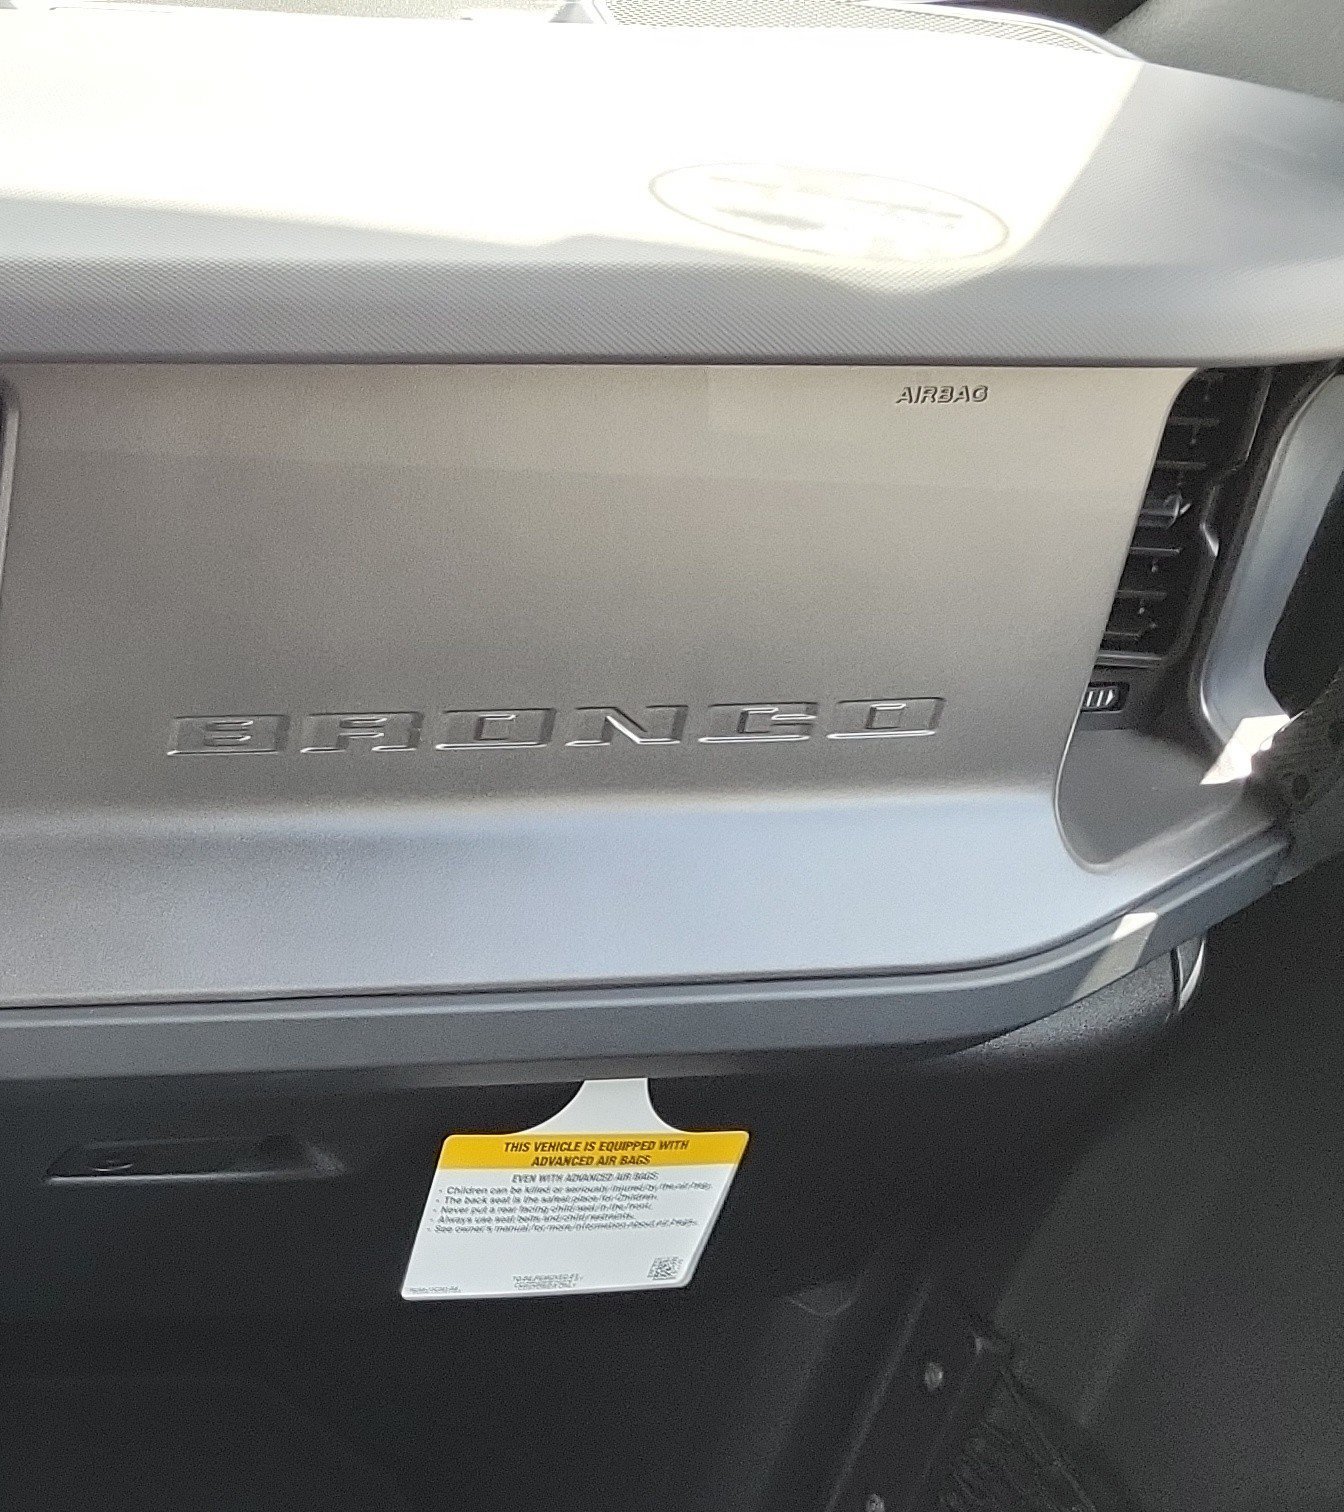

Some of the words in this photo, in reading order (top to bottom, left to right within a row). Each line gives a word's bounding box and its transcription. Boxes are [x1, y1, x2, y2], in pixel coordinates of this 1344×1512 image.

[895, 384, 989, 404] AIRBAG
[167, 696, 947, 756] BRONCO
[504, 1141, 531, 1152] THIS
[533, 1141, 581, 1152] VEHICLE
[583, 1141, 596, 1152] IS
[599, 1140, 656, 1152] EQUIPPED
[659, 1139, 690, 1150] WITH
[531, 1155, 594, 1167] ADVANCED
[596, 1155, 616, 1166] AIR
[619, 1154, 652, 1166] BAGS
